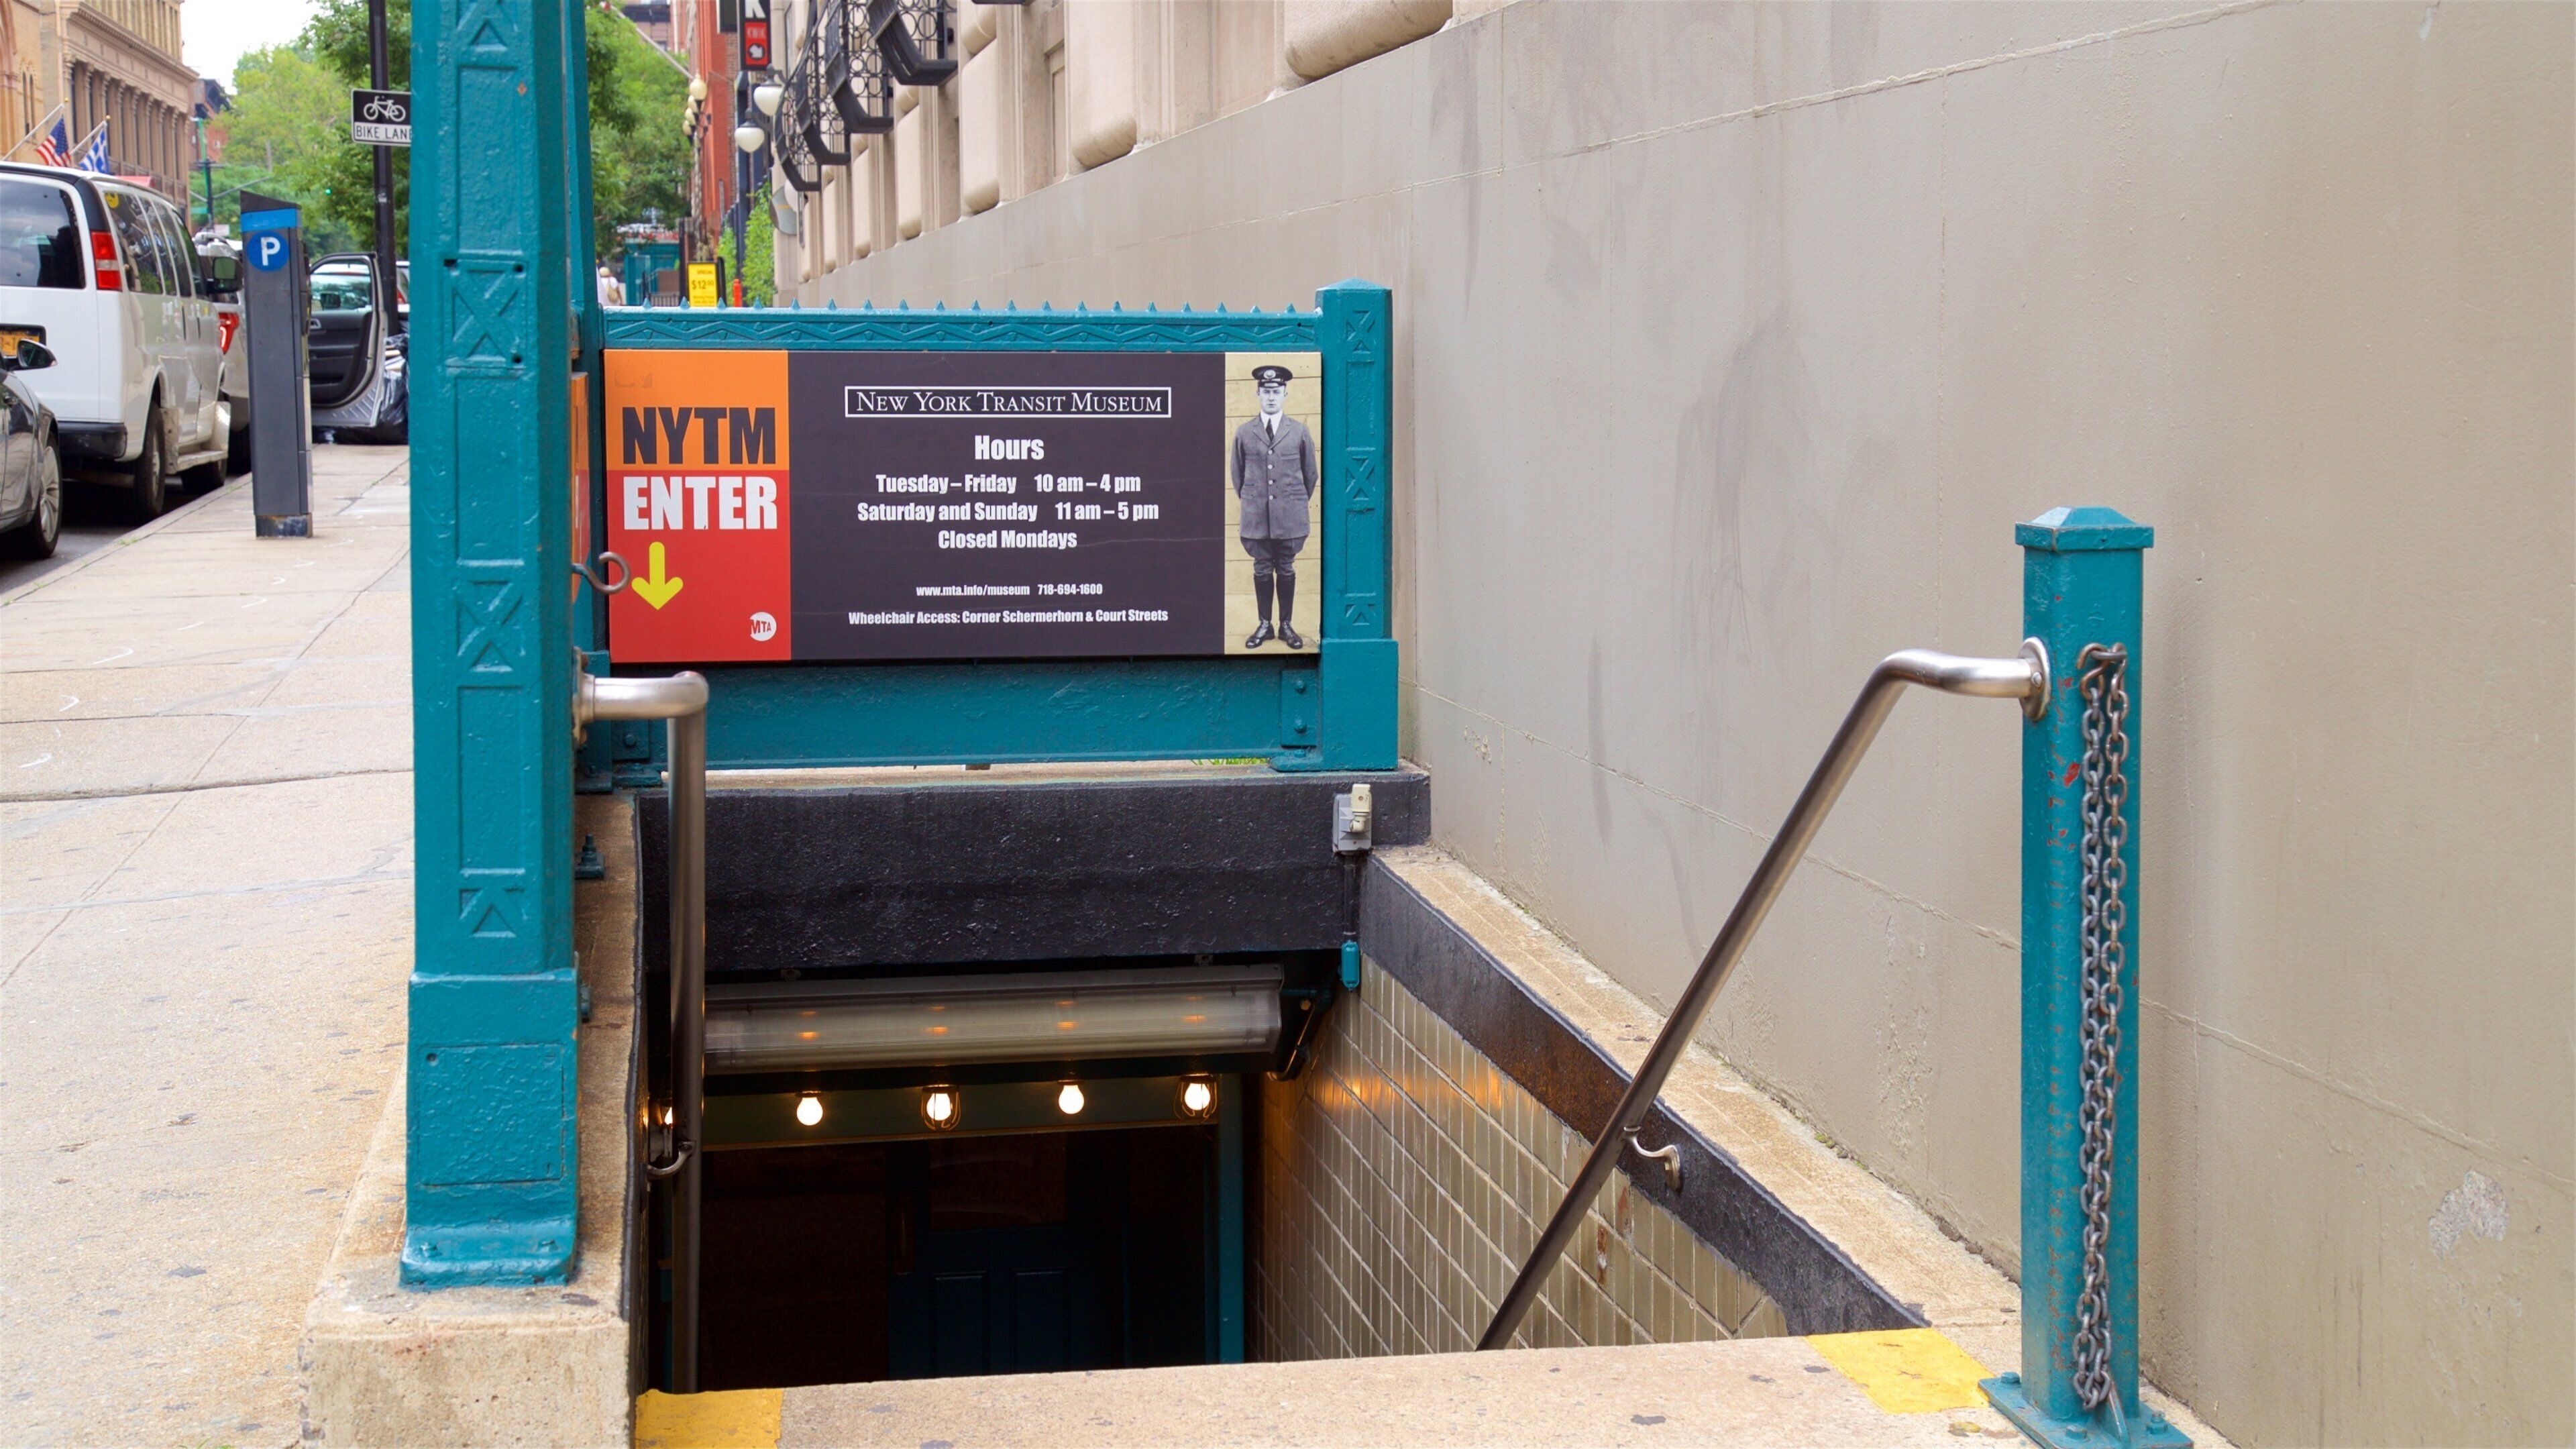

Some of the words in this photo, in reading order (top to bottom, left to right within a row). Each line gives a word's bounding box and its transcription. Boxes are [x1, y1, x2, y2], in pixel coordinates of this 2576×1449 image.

[356, 125, 379, 138] BIKE
[260, 236, 280, 266] P
[857, 392, 908, 411] NEW
[914, 392, 971, 411] YORK
[977, 392, 1065, 411] TRANSIT
[1071, 392, 1162, 412] MUSEUM
[623, 407, 775, 465] NYTM
[975, 435, 1044, 460] Hours
[875, 474, 949, 494] Tuesday
[965, 474, 1017, 494] Friday
[1034, 474, 1054, 492] 10
[1057, 476, 1083, 492] am
[1100, 474, 1112, 492] 4
[1114, 476, 1141, 494] pm
[623, 476, 777, 531] ENTER
[857, 502, 936, 523] Saturday
[938, 502, 971, 521] and
[974, 502, 1038, 522] Sunday
[1055, 502, 1071, 521] 11
[1074, 504, 1101, 521] am
[1118, 501, 1129, 520] 5
[1132, 504, 1159, 522] pm
[938, 530, 998, 549] Closed
[1001, 529, 1077, 550] Mondays
[916, 584, 1030, 596] www.mta.info/museum
[1037, 584, 1103, 596] 718-694-1600
[750, 619, 771, 634] MTA
[848, 611, 916, 625] Wheelchair
[916, 611, 961, 624] Access:
[962, 610, 1002, 624] Corner
[1002, 610, 1084, 623] Schermerhorn
[1085, 611, 1094, 623] &
[1095, 609, 1127, 622] Court
[1128, 608, 1169, 622] Streets
